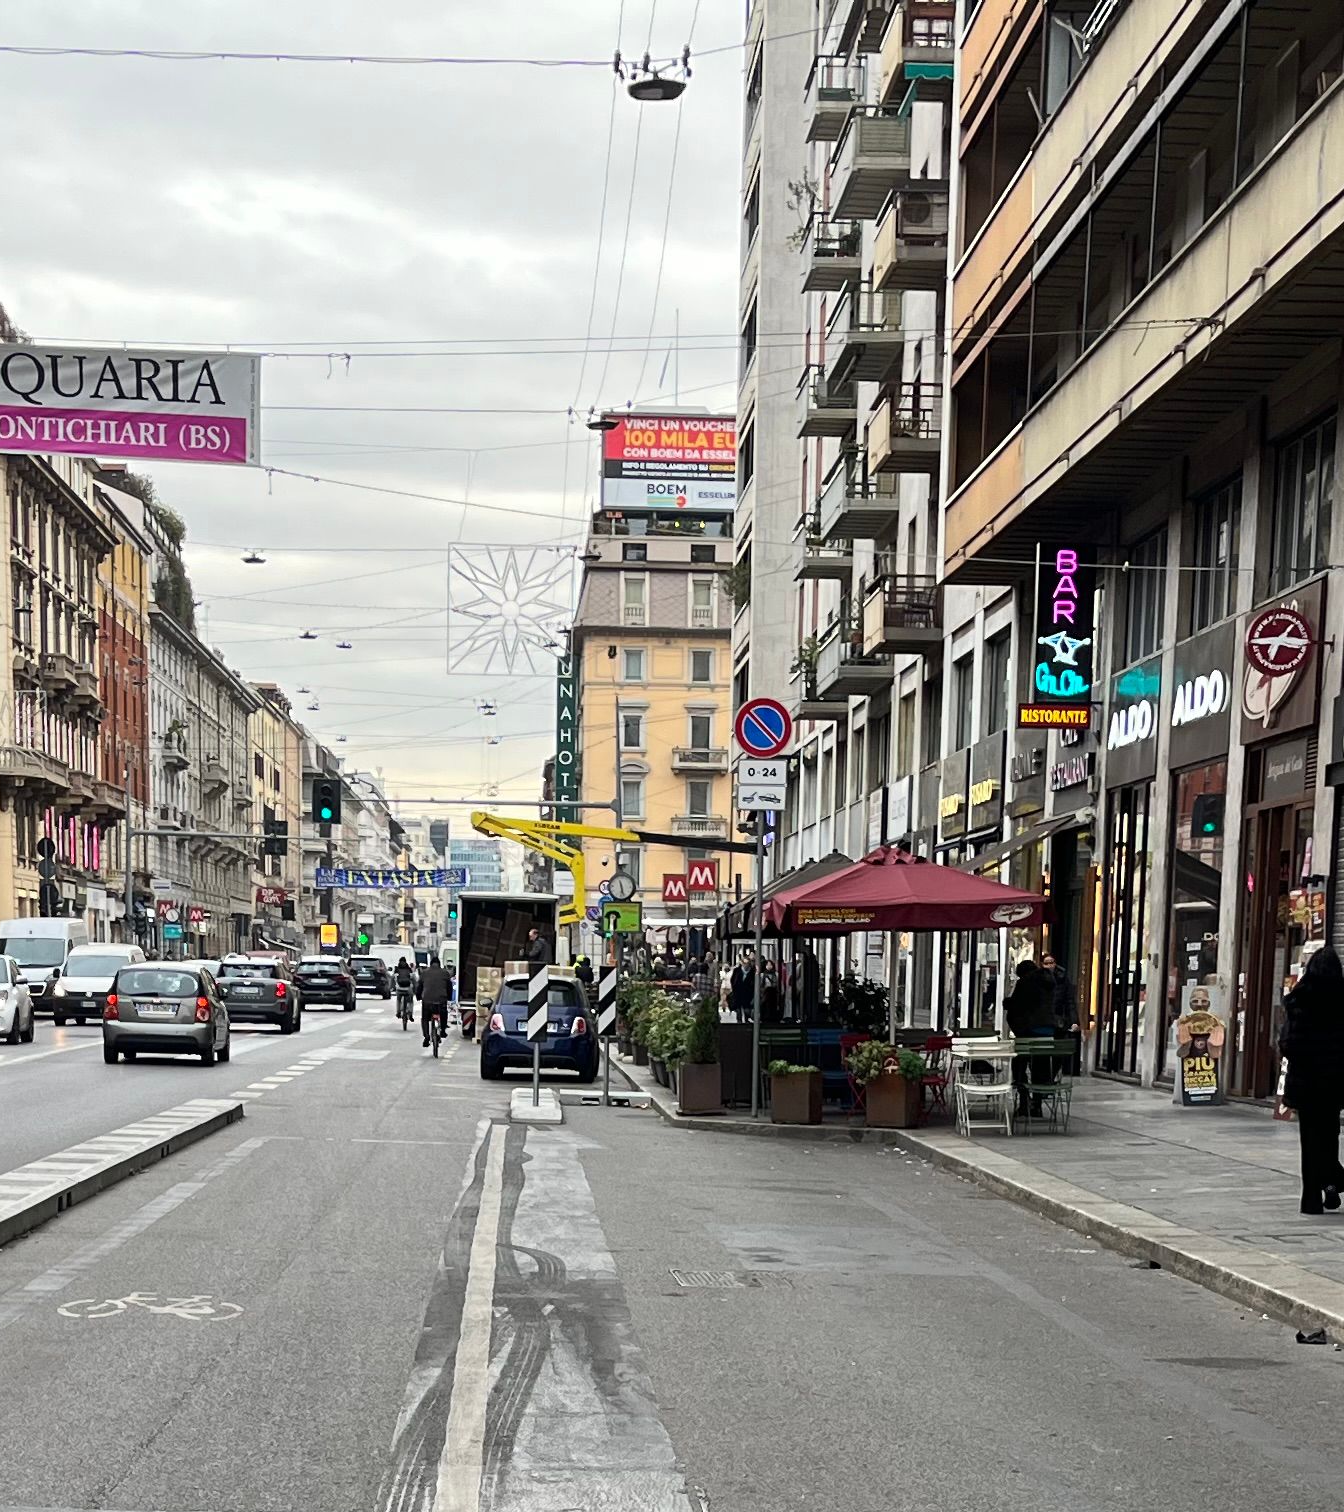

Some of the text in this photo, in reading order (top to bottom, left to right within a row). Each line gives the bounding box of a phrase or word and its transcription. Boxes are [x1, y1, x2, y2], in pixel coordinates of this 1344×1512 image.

[623, 418, 659, 430] VINCI
[660, 420, 680, 430] UN
[178, 423, 232, 454] (BS)
[623, 430, 656, 447] 100
[660, 431, 709, 448] MILA
[622, 447, 649, 458] CON
[650, 448, 682, 459] BOEM
[684, 449, 701, 459] DA
[646, 483, 687, 495] BOEM
[1052, 550, 1078, 625] BAR
[1172, 668, 1224, 727] ALDO
[1020, 708, 1088, 724] RISTORANTE
[1107, 699, 1152, 751] ALDO
[689, 866, 714, 886] M
[664, 880, 686, 897] M
[1183, 1052, 1216, 1072] PIÙ
